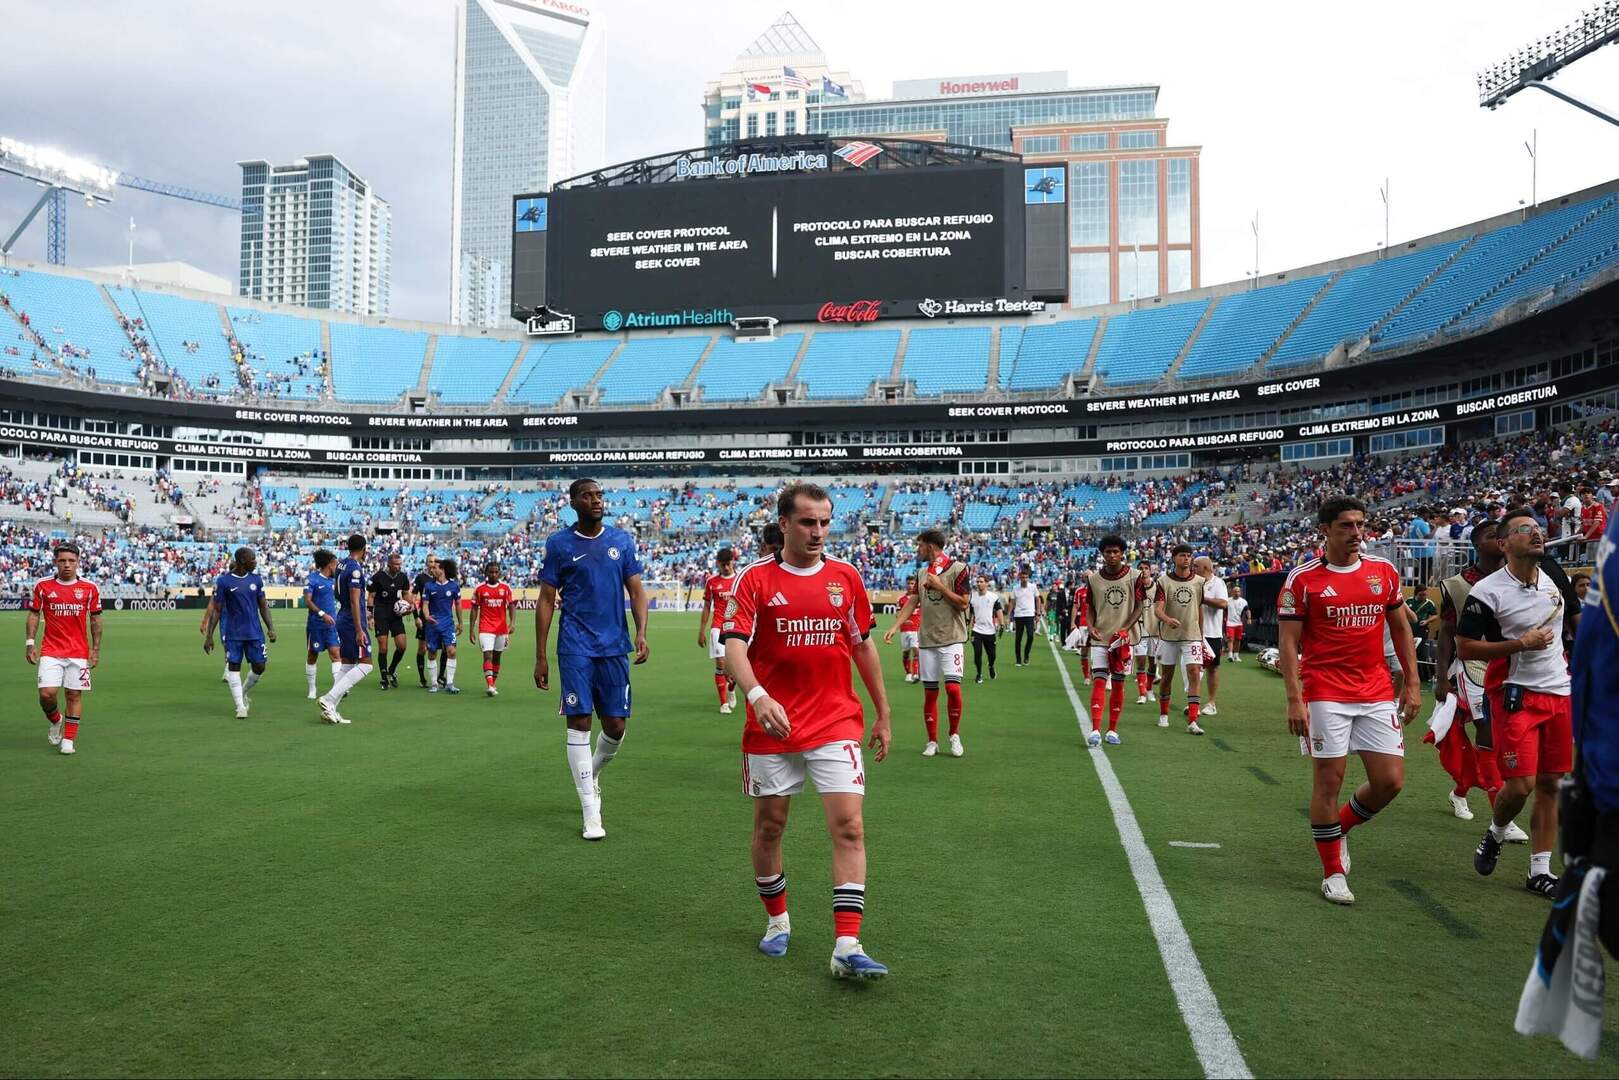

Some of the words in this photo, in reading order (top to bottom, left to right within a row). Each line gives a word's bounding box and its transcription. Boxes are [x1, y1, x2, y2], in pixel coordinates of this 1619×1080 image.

[940, 77, 1019, 95] Honeywell
[677, 156, 725, 177] Bank
[725, 153, 747, 173] of
[748, 151, 828, 172] America
[793, 220, 861, 232] PROTOCOLO
[863, 218, 893, 229] PARA
[894, 216, 941, 227] BUSCAR
[943, 214, 994, 225] REFUGIO
[606, 231, 634, 242] SEEK
[636, 229, 672, 240] COVER
[673, 226, 730, 238] PROTOCOL
[814, 236, 849, 246] CLIMA
[850, 233, 904, 244] EXTREMO
[905, 232, 921, 242] EN
[923, 232, 938, 241] LA
[939, 230, 971, 241] ZONA
[590, 246, 630, 257] SEVERE
[632, 243, 682, 255] WEATHER
[683, 242, 694, 252] IN
[696, 241, 717, 251] THE
[718, 240, 748, 250] AREA
[834, 249, 880, 260] BUSCAR
[882, 246, 951, 258] COBERTURA
[635, 259, 662, 270] SEEK
[664, 257, 700, 268] COVER
[945, 301, 994, 314] Harris
[995, 299, 1045, 312] Teeter
[625, 311, 680, 327] Atrium
[682, 308, 733, 325] Health
[1258, 383, 1284, 396] SEEK
[1285, 378, 1320, 392] COVER
[1087, 400, 1126, 412] SEVERE
[1128, 396, 1176, 409] WEATHER
[1178, 395, 1188, 404] IN
[1190, 392, 1210, 403] THE
[1211, 390, 1240, 401] AREA
[1457, 398, 1495, 415] BUSCAR
[1497, 385, 1558, 407] COBERTURA
[235, 410, 262, 420] SEEK
[263, 412, 298, 422] COVER
[299, 414, 352, 425] PROTOCOL
[948, 408, 975, 416] SEEK
[977, 407, 1012, 416] COVER
[1014, 404, 1068, 415] PROTOCOL
[368, 417, 406, 426] SEVERE
[407, 418, 451, 427] WEATHER
[453, 418, 462, 427] IN
[464, 418, 482, 427] THE
[483, 418, 508, 427] AREA
[523, 417, 546, 426] SEEK
[547, 416, 578, 425] COVER
[1299, 424, 1330, 436] CLIMA
[1331, 418, 1380, 433] EXTREMO
[1382, 416, 1395, 426] EN
[1397, 414, 1410, 424] LA
[1411, 409, 1440, 422] ZONA
[40, 431, 68, 443] PARA
[69, 434, 112, 447] BUSCAR
[114, 438, 159, 450] REFUGIO
[1107, 439, 1167, 451] PROTOCOLO
[1169, 437, 1196, 447] PARA
[1197, 434, 1237, 445] BUSCAR
[1239, 430, 1284, 442] REFUGIO
[174, 444, 206, 454] CLIMA
[208, 446, 254, 456] EXTREMO
[256, 448, 269, 457] EN
[270, 449, 284, 458] LA
[284, 450, 311, 459] ZONA
[326, 452, 364, 461] BUSCAR
[366, 453, 422, 462] COBERTURA
[550, 453, 602, 462] PROTOCOLO
[603, 452, 627, 461] PARA
[628, 451, 664, 460] BUSCAR
[666, 450, 705, 460] REFUGIO
[719, 450, 748, 459] CLIMA
[748, 449, 792, 458] EXTREMO
[794, 449, 807, 457] EN
[808, 449, 821, 457] LA
[822, 448, 848, 457] ZONA
[863, 448, 902, 456] BUSCAR
[904, 447, 963, 456] COBERTURA
[130, 598, 177, 611] motorola
[1326, 602, 1384, 618] Emirates
[776, 616, 843, 633] Emirates
[1336, 616, 1350, 627] FLY
[1351, 615, 1377, 627] BETTER
[786, 633, 803, 647] FLY
[804, 632, 837, 646] BETTER
